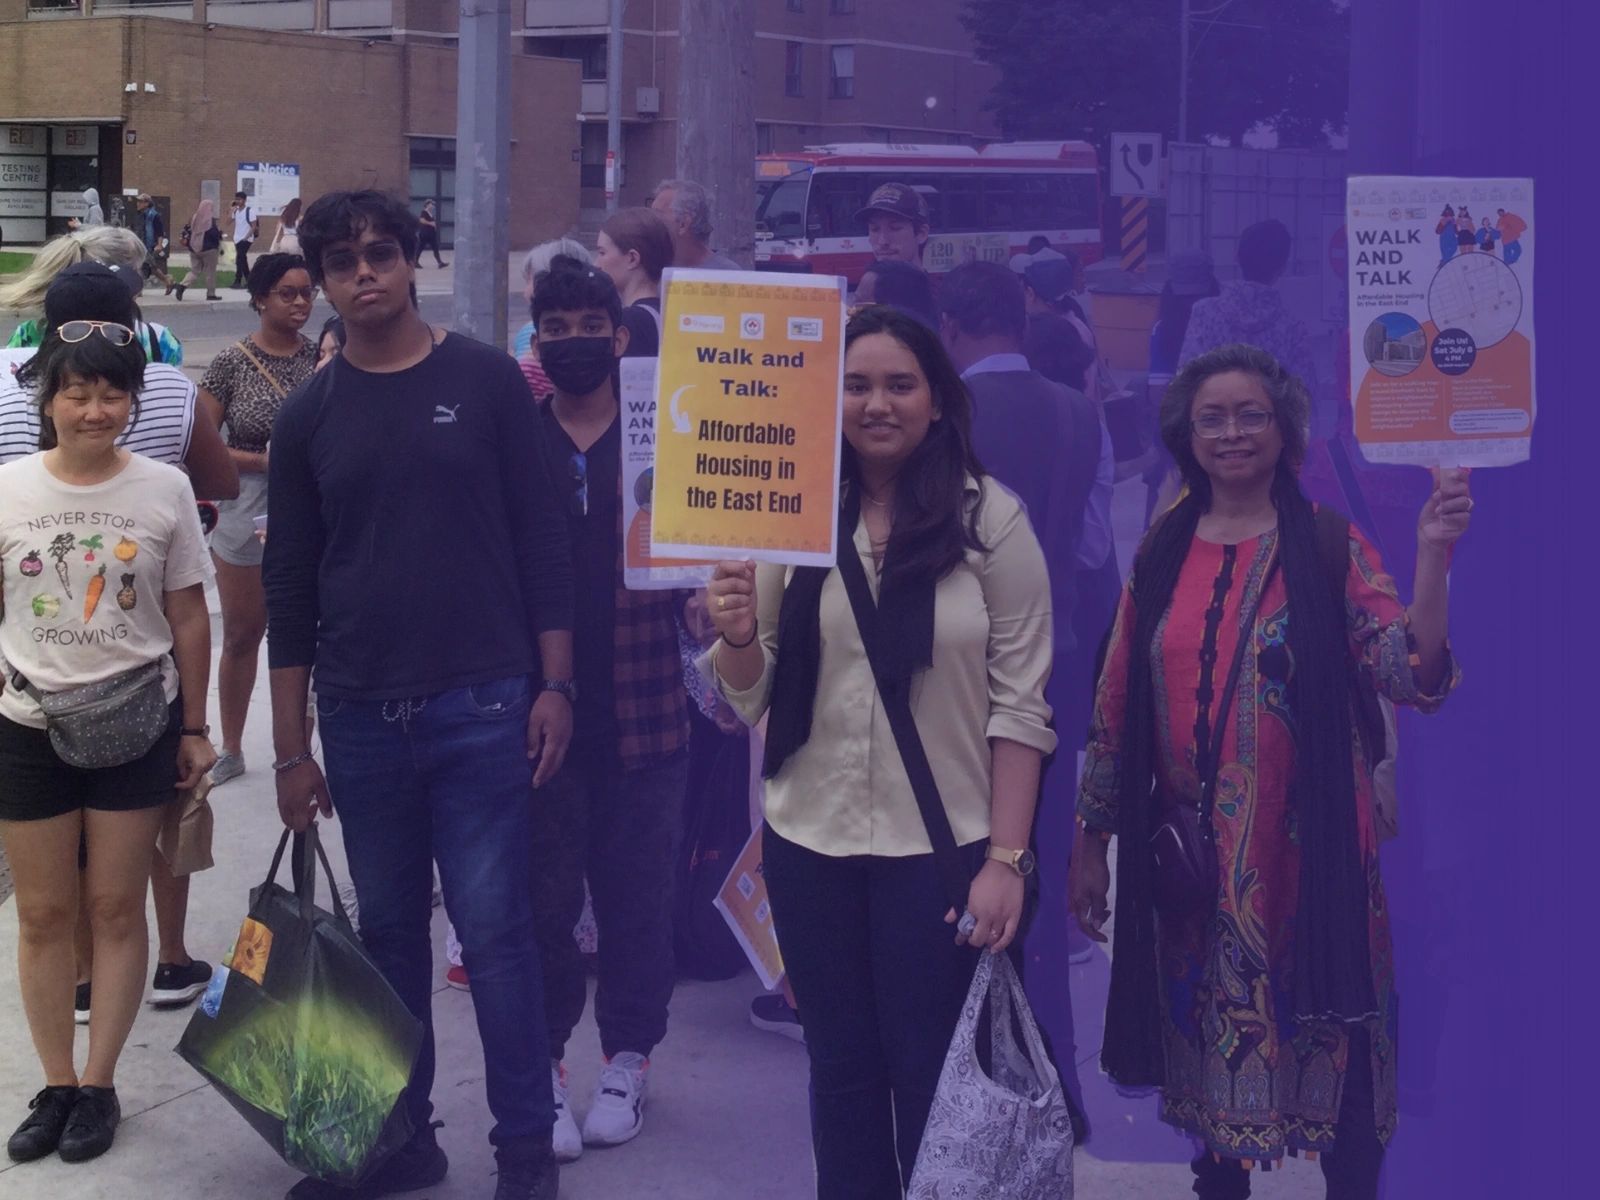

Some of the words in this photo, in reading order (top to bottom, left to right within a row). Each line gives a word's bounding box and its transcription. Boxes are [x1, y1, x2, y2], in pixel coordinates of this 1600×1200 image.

[1, 163, 40, 173] TESTING
[259, 162, 296, 176] Notice
[2, 173, 39, 183] CENTRE
[1355, 229, 1421, 245] WALK
[929, 242, 954, 257] 120
[1356, 250, 1403, 266] AND
[1356, 270, 1413, 286] TALK
[1438, 337, 1455, 345] Join
[696, 346, 753, 365] Walk
[761, 351, 804, 368] and
[1433, 346, 1448, 354] Sat
[1449, 345, 1466, 355] July
[720, 379, 778, 398] Talk:
[628, 401, 657, 413] WA
[628, 417, 654, 429] AN
[628, 433, 656, 446] TA
[698, 420, 796, 446] Affordable
[696, 453, 772, 481] Housing
[778, 457, 796, 480] in
[687, 486, 717, 509] the
[723, 489, 763, 512] East
[768, 491, 802, 514] End
[28, 512, 85, 531] NEVER
[90, 512, 136, 530] STOP
[32, 624, 128, 645] GROWING
